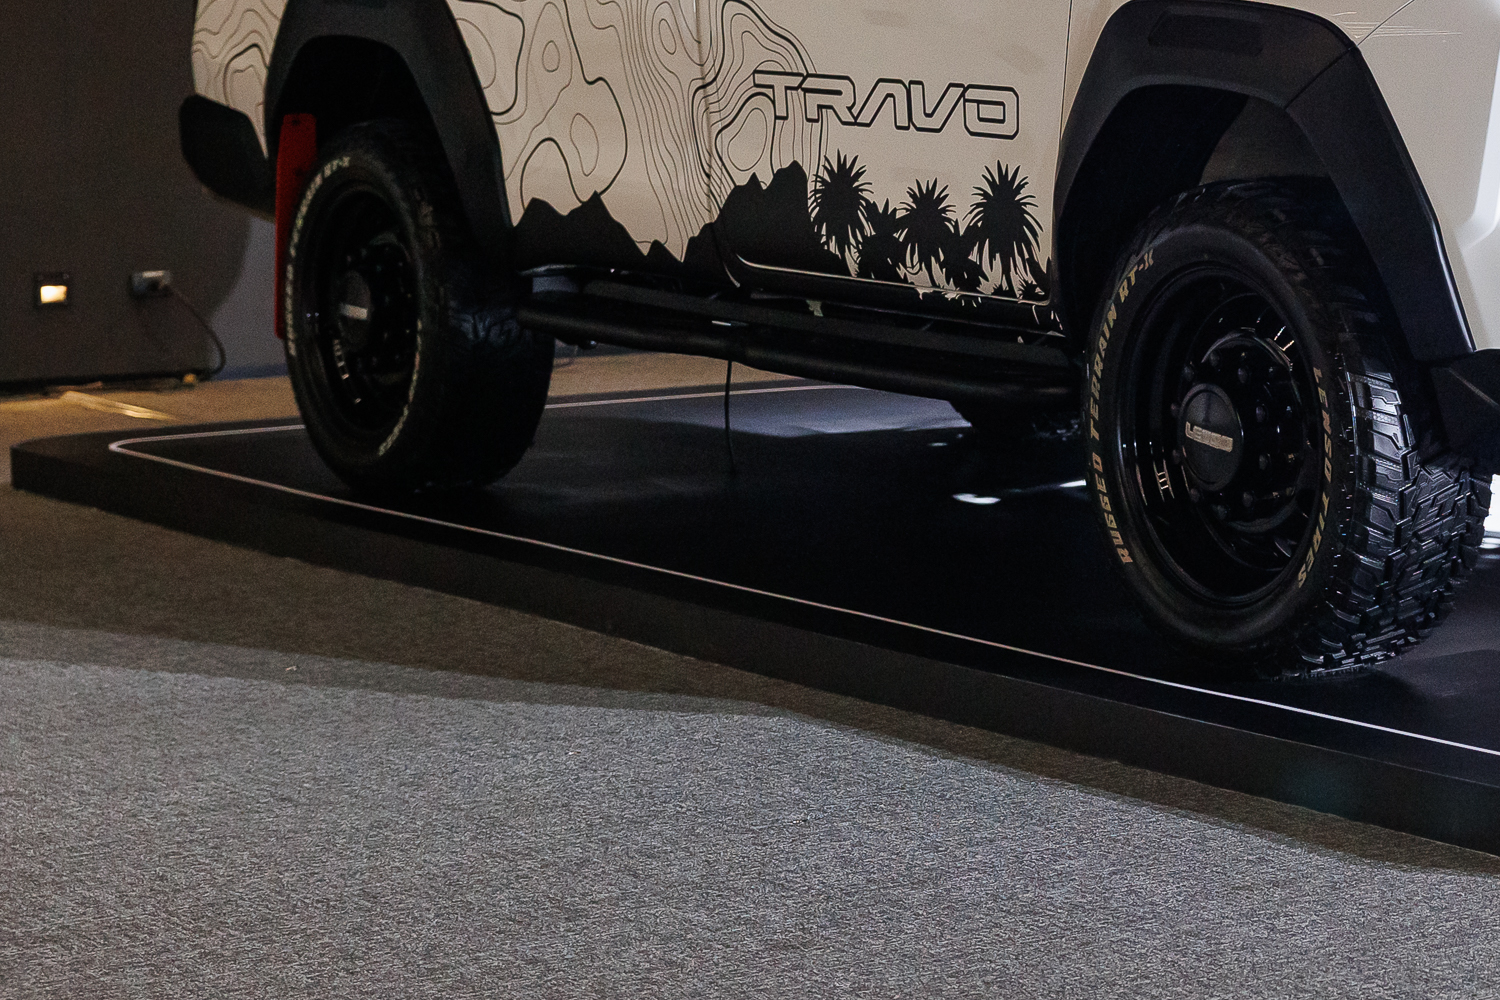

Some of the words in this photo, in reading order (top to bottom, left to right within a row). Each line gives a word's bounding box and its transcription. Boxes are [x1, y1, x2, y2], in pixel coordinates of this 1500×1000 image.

[753, 69, 1020, 140] TRAVO
[1090, 303, 1117, 441] TERRAIN
[1313, 367, 1332, 483] LENSO
[1092, 452, 1133, 564] RUGGED
[1298, 491, 1329, 589] TIRES
